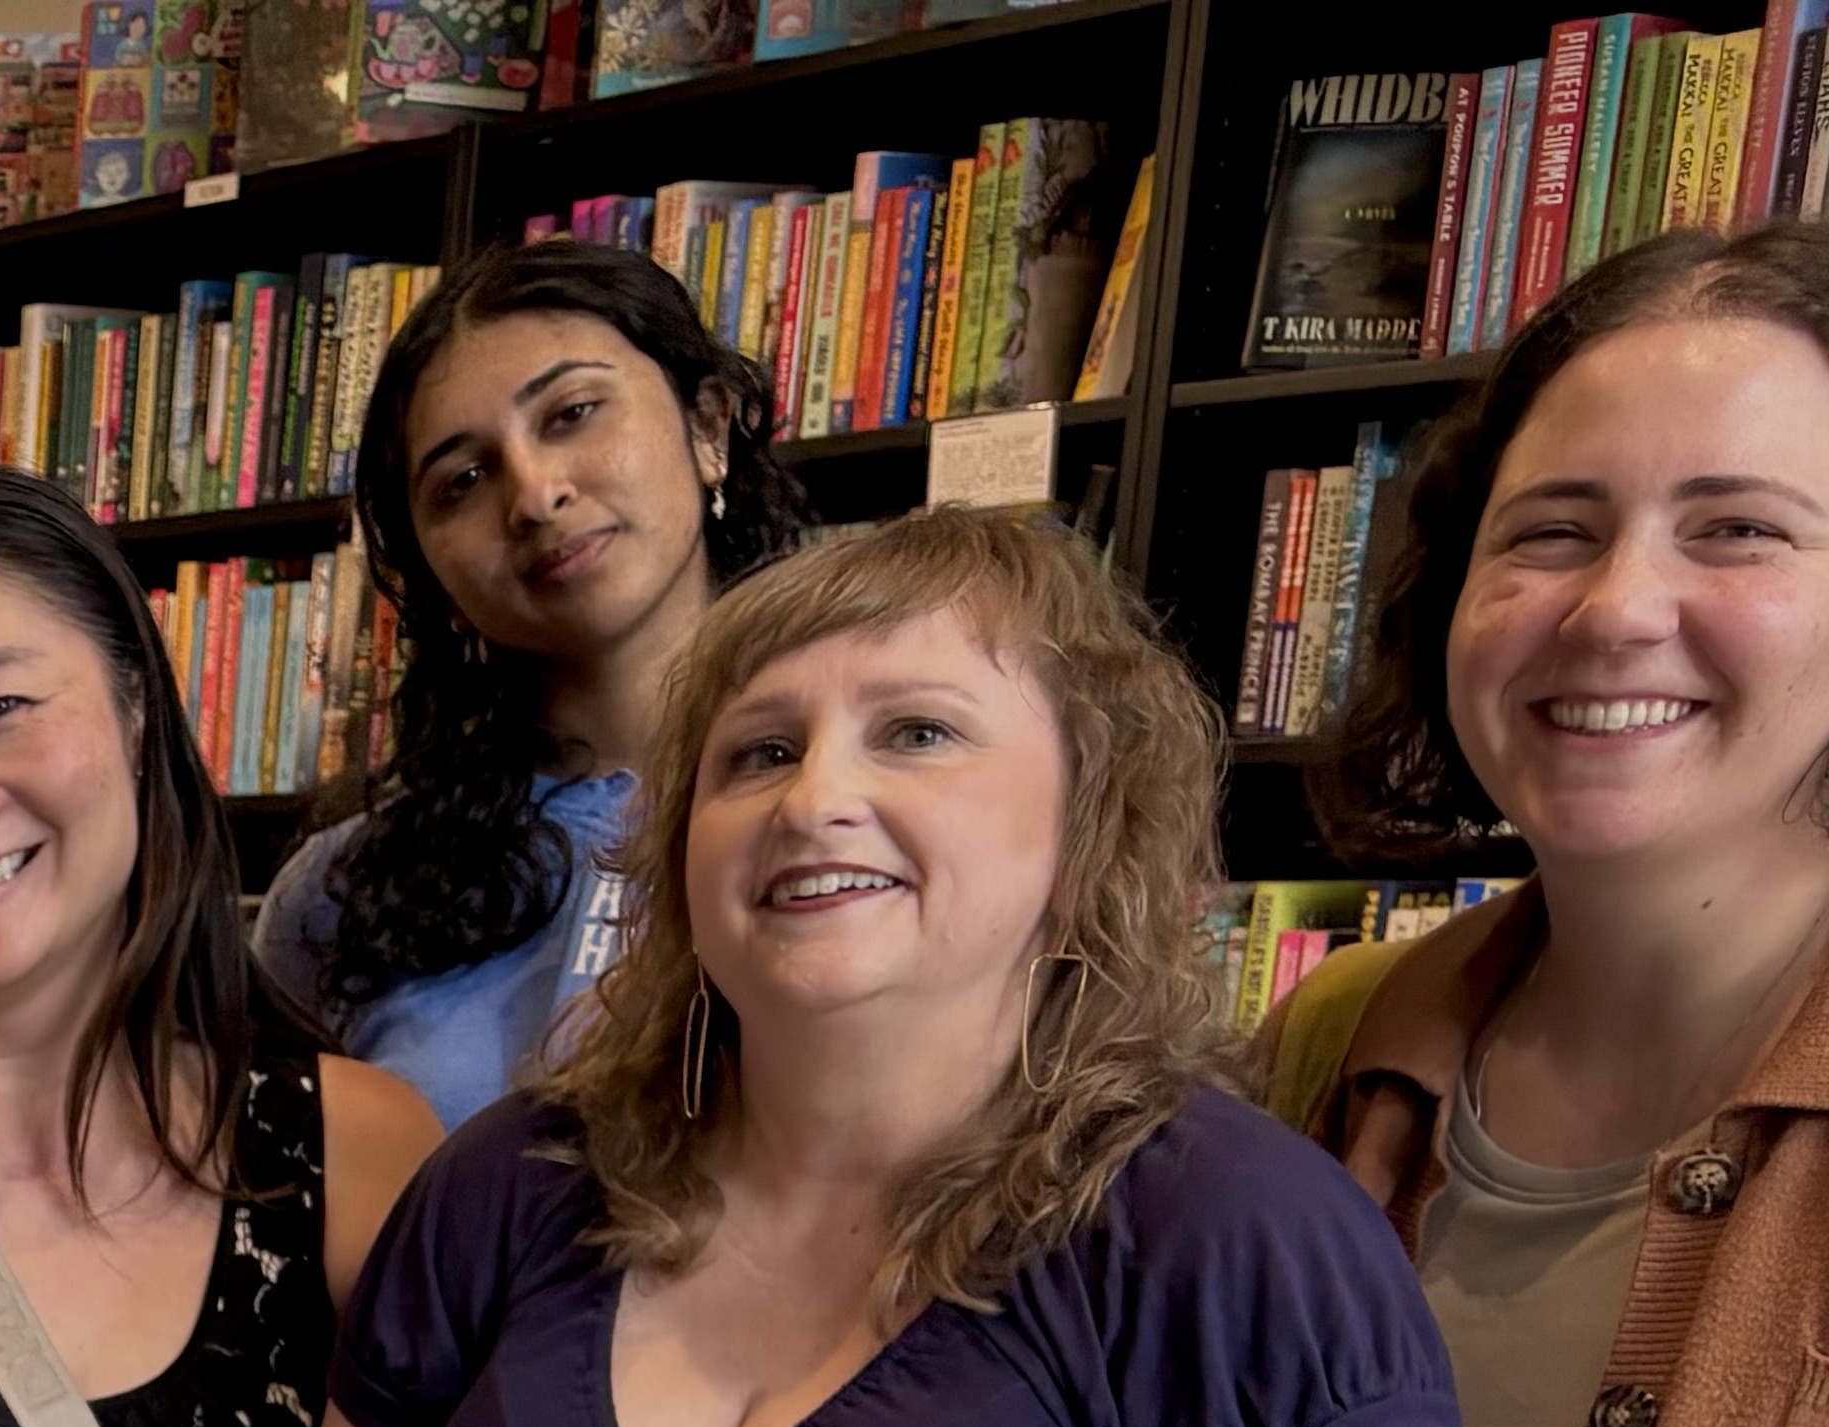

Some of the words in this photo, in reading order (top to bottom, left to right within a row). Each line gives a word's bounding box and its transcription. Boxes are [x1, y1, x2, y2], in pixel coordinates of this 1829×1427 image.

[1547, 30, 1588, 116] PIONEER
[1597, 33, 1616, 92] SUSAN
[1681, 53, 1702, 117] MAKKAI
[1716, 47, 1736, 111] MAKKAI
[1291, 73, 1448, 127] WHIDB
[1533, 121, 1575, 206] SUMMER
[1672, 147, 1695, 201] GREAT
[1707, 141, 1728, 196] GREAT
[1284, 316, 1336, 342] KIRA
[1345, 317, 1421, 342] MADDE
[1262, 502, 1284, 536] THE
[1249, 543, 1277, 624] BOMBAY
[1238, 628, 1264, 699] PRINCE
